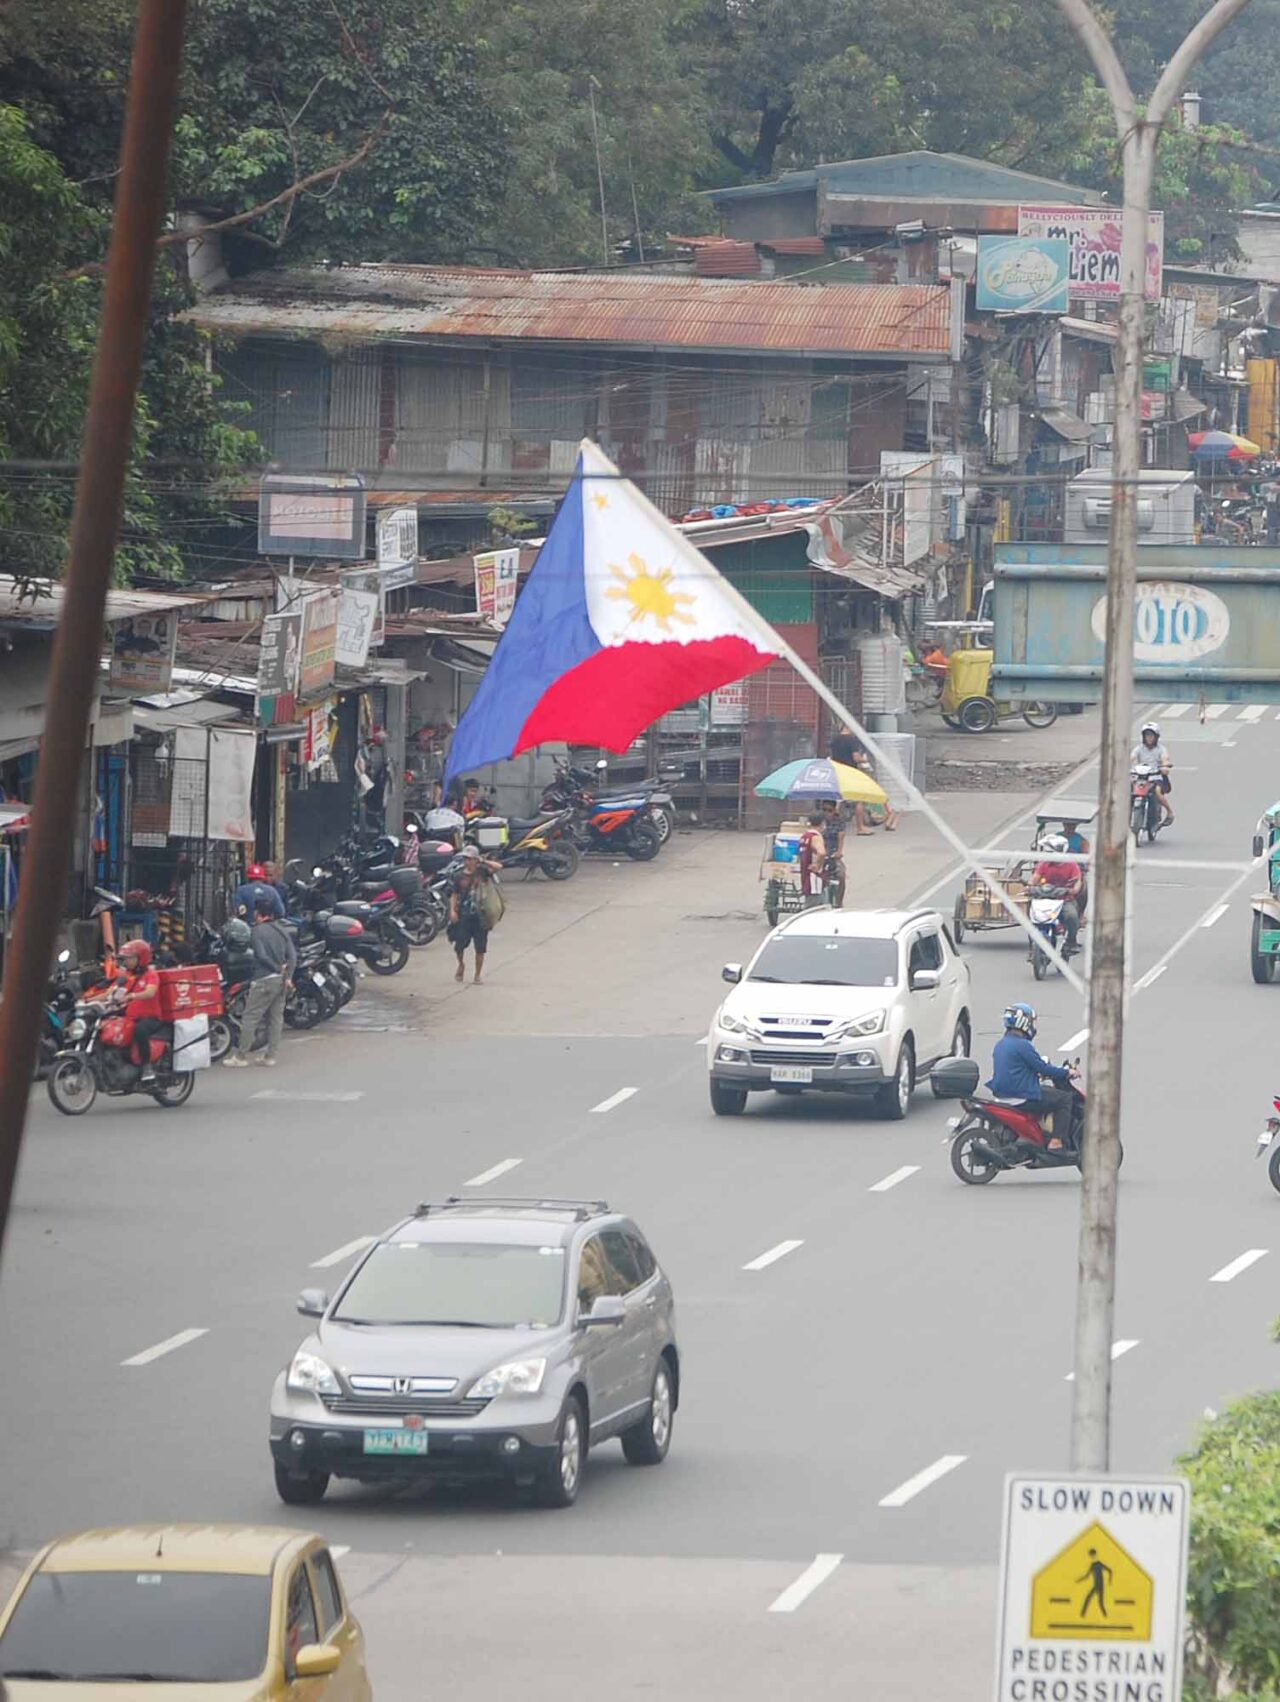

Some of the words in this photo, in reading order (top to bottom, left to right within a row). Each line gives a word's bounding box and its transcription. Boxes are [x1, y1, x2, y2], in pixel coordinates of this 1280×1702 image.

[1137, 598, 1198, 644] OTO
[1021, 1487, 1090, 1511] SLOW
[1101, 1490, 1175, 1514] DOWN
[1011, 1649, 1166, 1674] PEDESTRIAN
[1010, 1678, 1163, 1702] CROSSING
